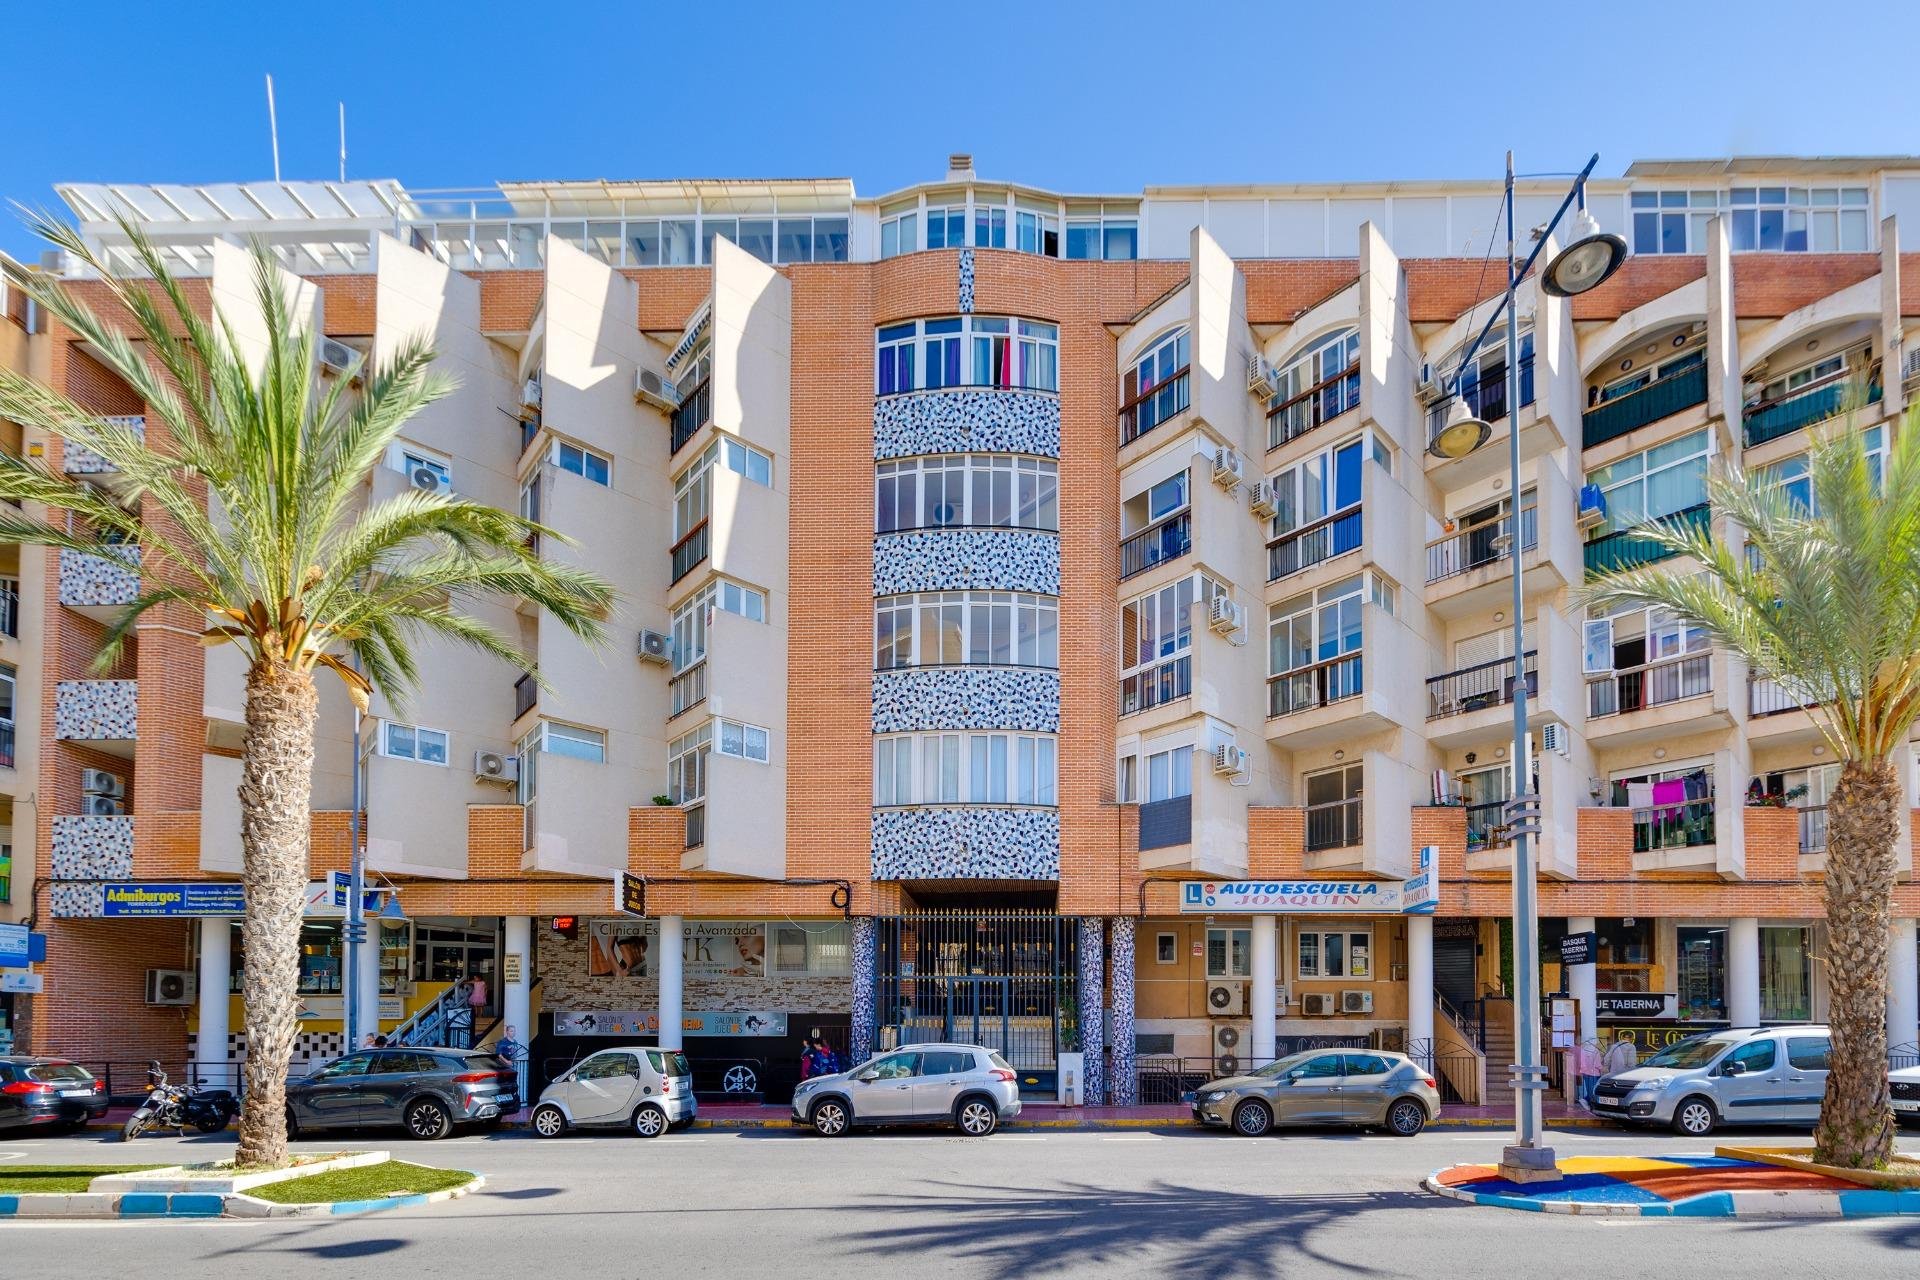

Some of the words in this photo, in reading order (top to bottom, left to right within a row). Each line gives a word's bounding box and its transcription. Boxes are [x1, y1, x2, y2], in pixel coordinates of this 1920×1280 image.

[1219, 883, 1377, 895] AUTOESCUELA
[107, 887, 181, 906] Admiburgos
[1234, 895, 1361, 906] JOAQUIN
[696, 923, 757, 936] Avanzada
[1433, 925, 1476, 937] BERNA
[1562, 936, 1587, 947] BASQUE
[1561, 945, 1588, 955] TABERNA
[1610, 999, 1660, 1009] TABERNA
